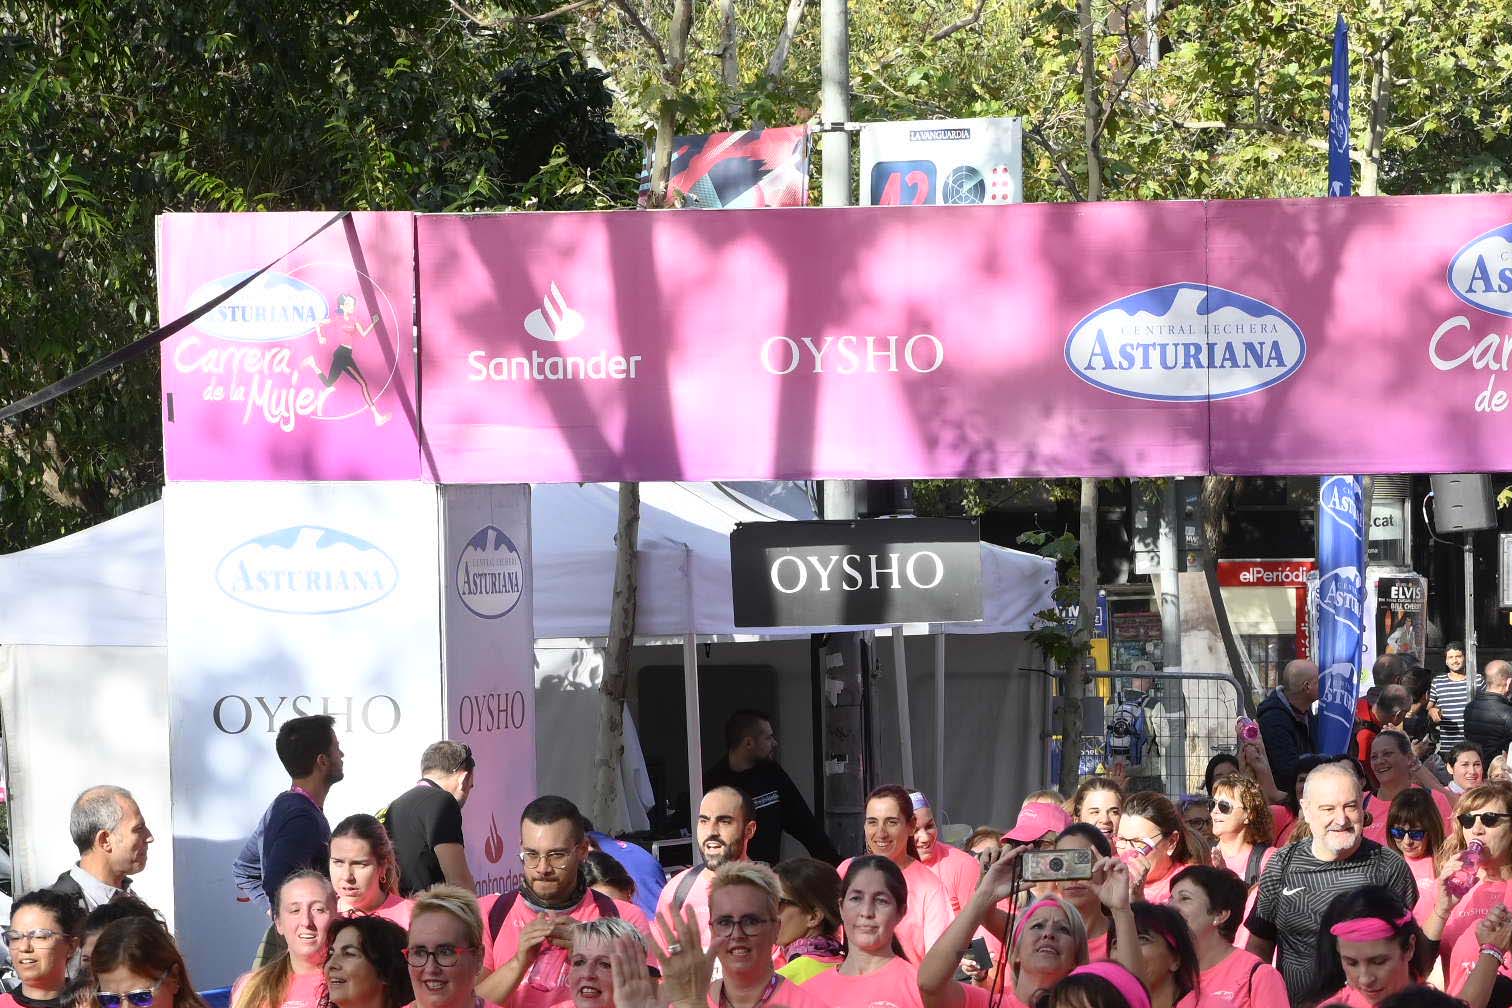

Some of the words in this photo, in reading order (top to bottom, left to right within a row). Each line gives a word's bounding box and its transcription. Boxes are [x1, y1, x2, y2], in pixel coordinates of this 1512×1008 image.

[1121, 323, 1195, 335] CENTRAL
[1205, 323, 1278, 335] LECHERA
[174, 336, 293, 373] Carrera
[467, 350, 641, 381] Santander
[761, 334, 943, 375] OYSHO
[1084, 328, 1287, 370] ASTURIANA
[203, 376, 223, 401] de
[229, 374, 246, 401] la
[242, 371, 337, 432] Mujer
[1474, 373, 1507, 412] de
[232, 560, 386, 593] ASTURIANA
[461, 560, 520, 596] ASTURIANA
[771, 551, 944, 594] OYSHO
[1391, 586, 1421, 599] ELVIS
[459, 691, 525, 735] OYSHO
